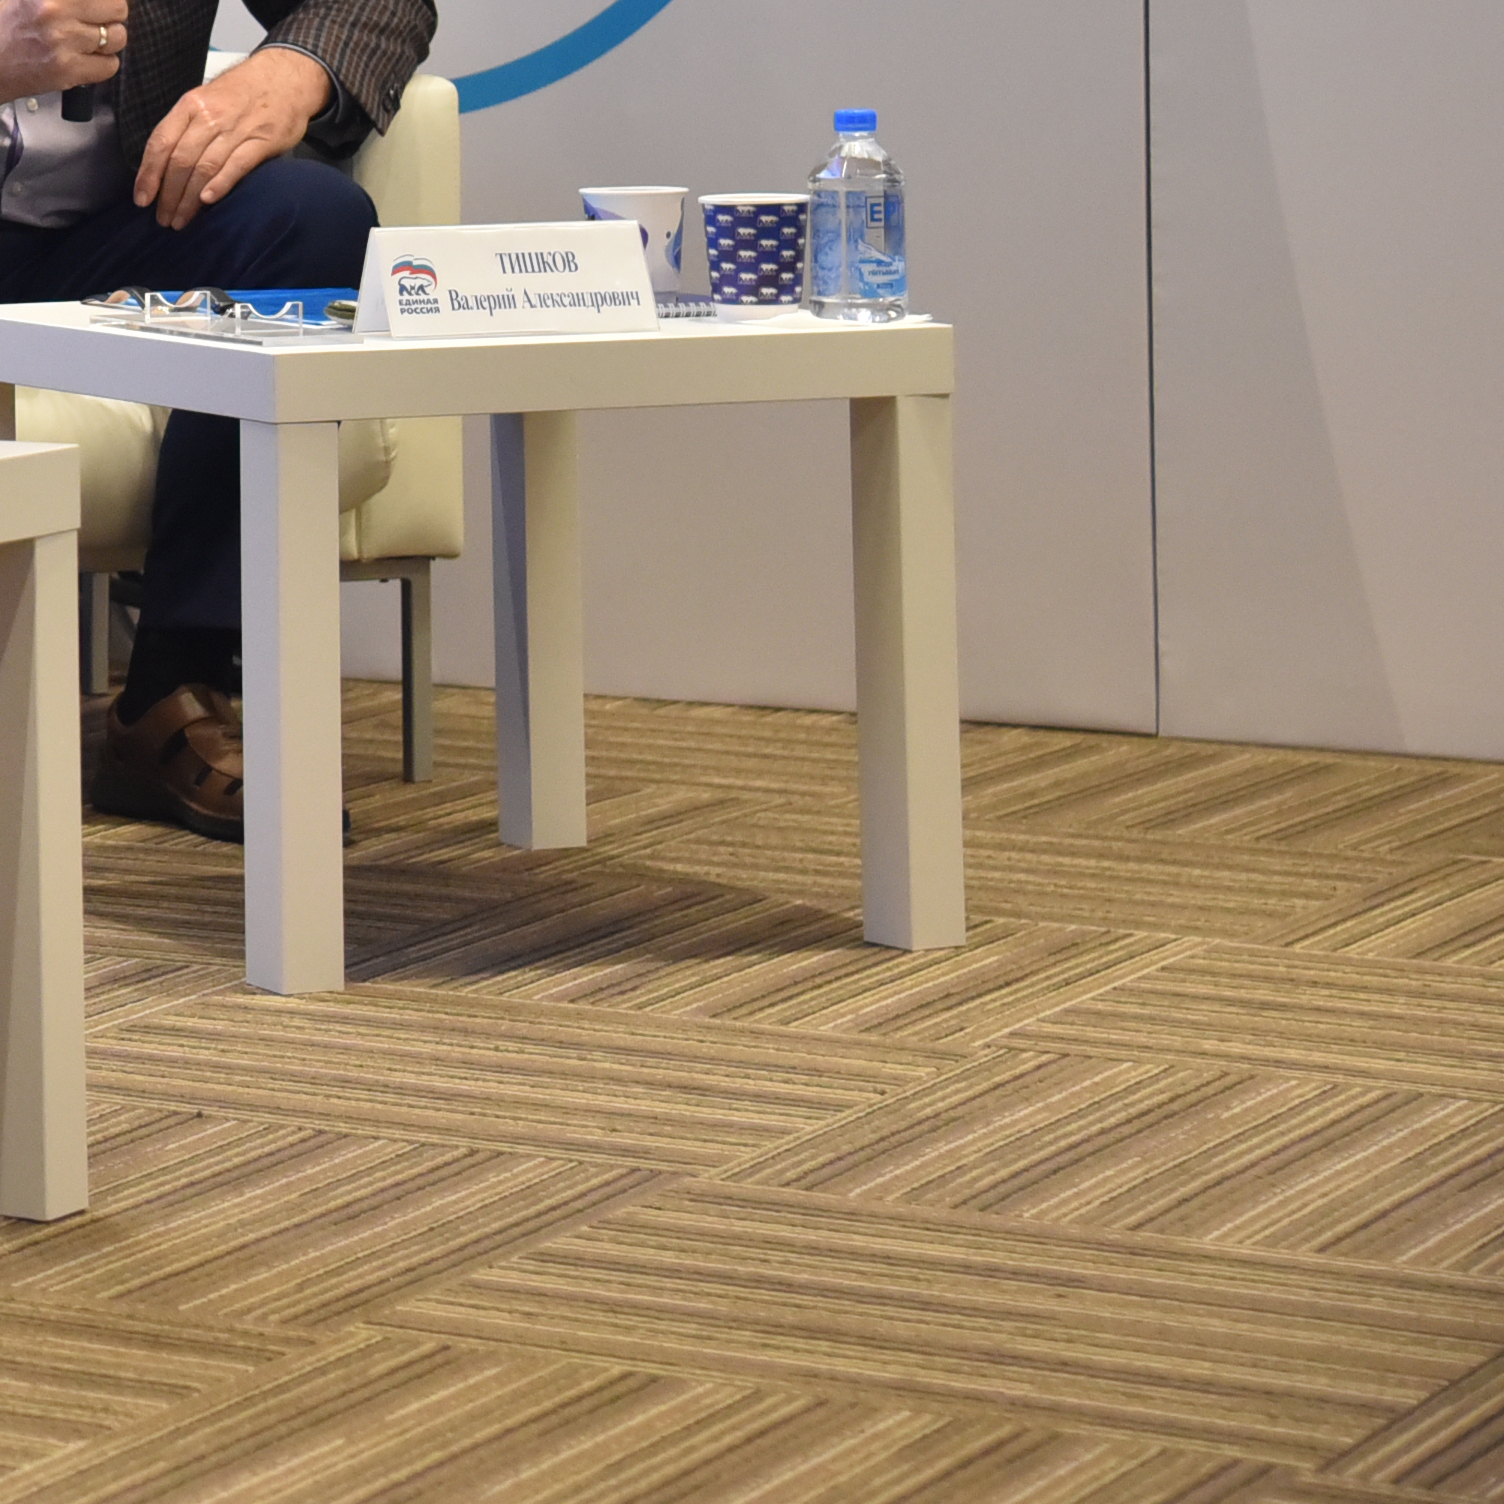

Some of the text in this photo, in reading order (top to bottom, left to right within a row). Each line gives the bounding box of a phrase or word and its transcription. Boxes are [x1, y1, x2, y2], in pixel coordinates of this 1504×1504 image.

[494, 251, 579, 275] ТИШКОВ
[398, 297, 439, 307] ЕДИНАЯ
[448, 288, 642, 316] Валерий Александрович
[399, 306, 441, 316] РОССИЯ
